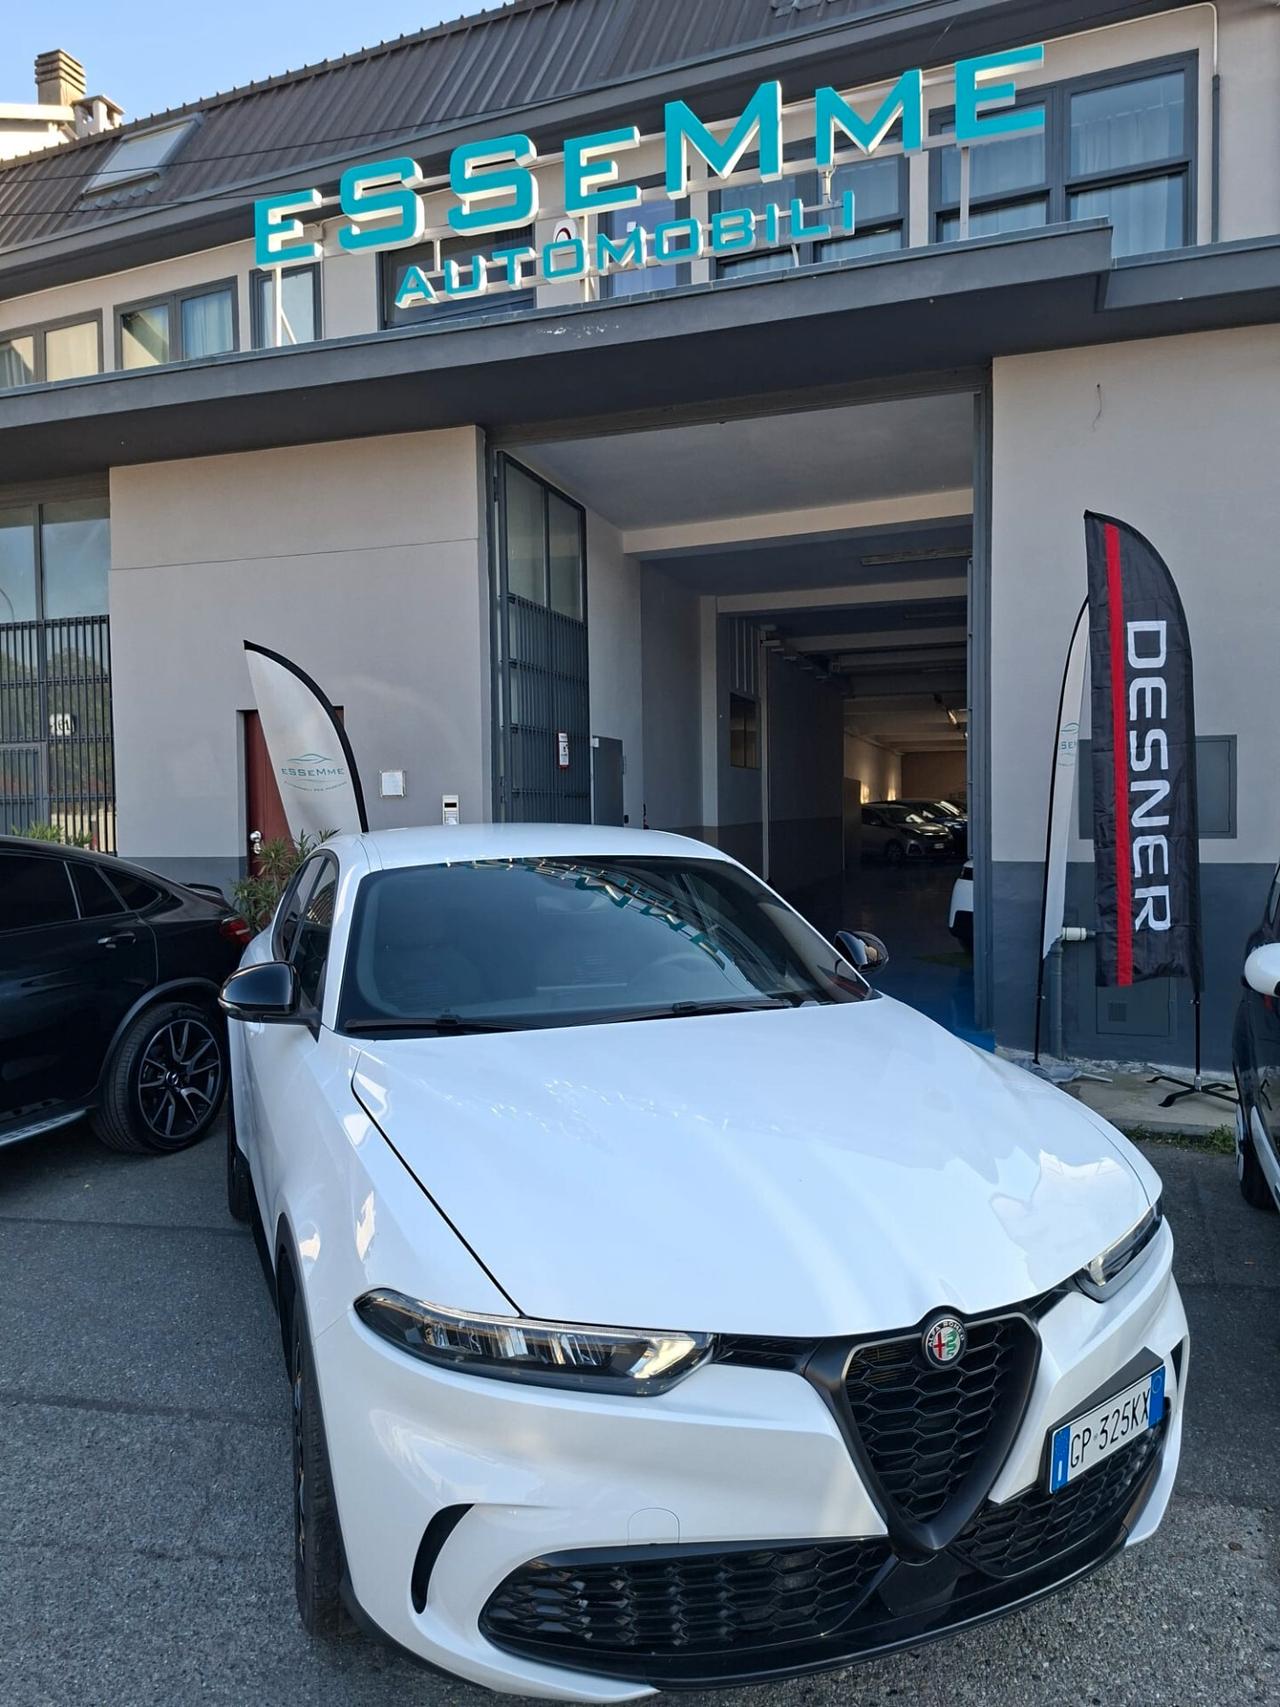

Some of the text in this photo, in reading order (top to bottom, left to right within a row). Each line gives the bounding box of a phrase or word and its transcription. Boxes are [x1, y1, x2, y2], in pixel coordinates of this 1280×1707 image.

[254, 45, 1045, 269] ESSEMME
[395, 190, 856, 308] AUTOMOBILI
[281, 768, 344, 776] ESSEMME
[1126, 620, 1172, 932] DESNER
[928, 1321, 965, 1347] ALFA ROMEO
[1070, 1387, 1151, 1468] GP 325KX
